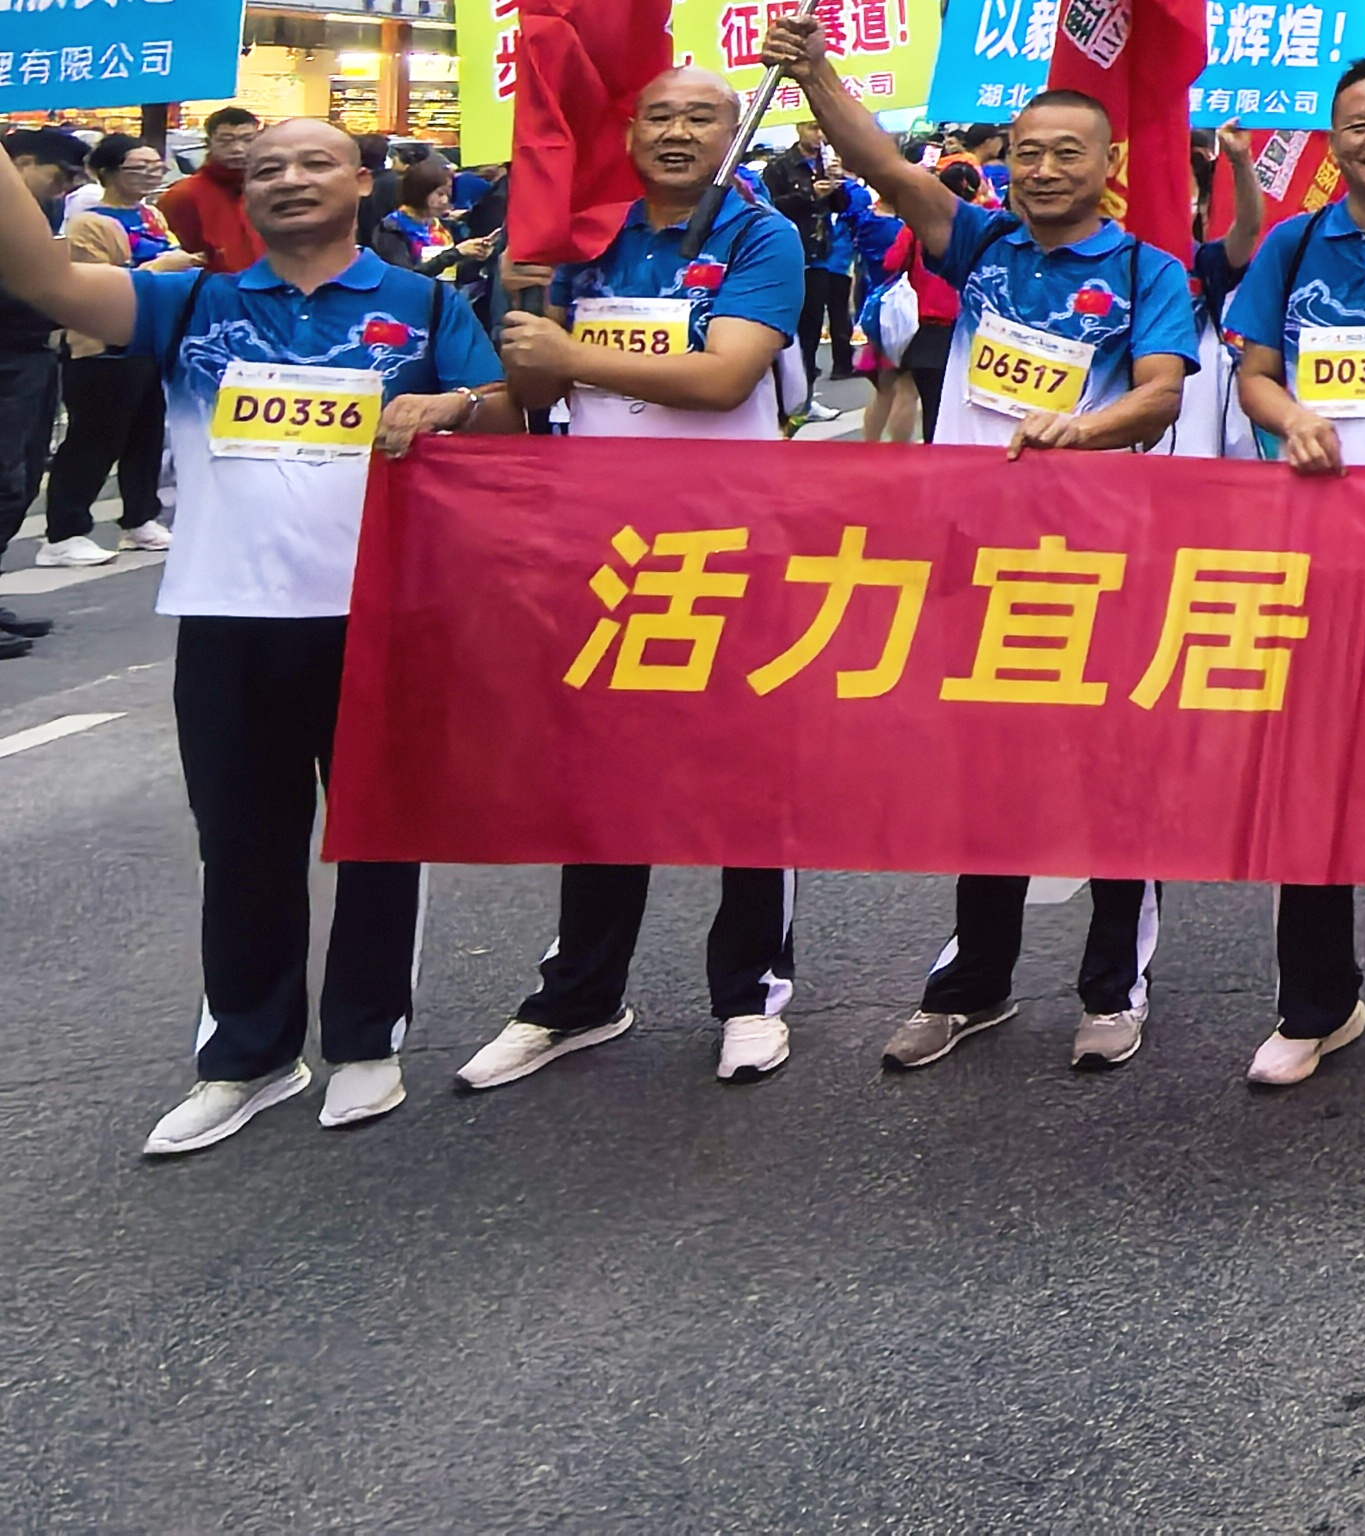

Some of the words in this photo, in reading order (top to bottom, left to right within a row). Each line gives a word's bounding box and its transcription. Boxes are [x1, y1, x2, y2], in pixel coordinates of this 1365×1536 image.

[975, 345, 1068, 394] D6517
[232, 395, 362, 429] D0336
[562, 525, 1310, 712] 活力宜居
